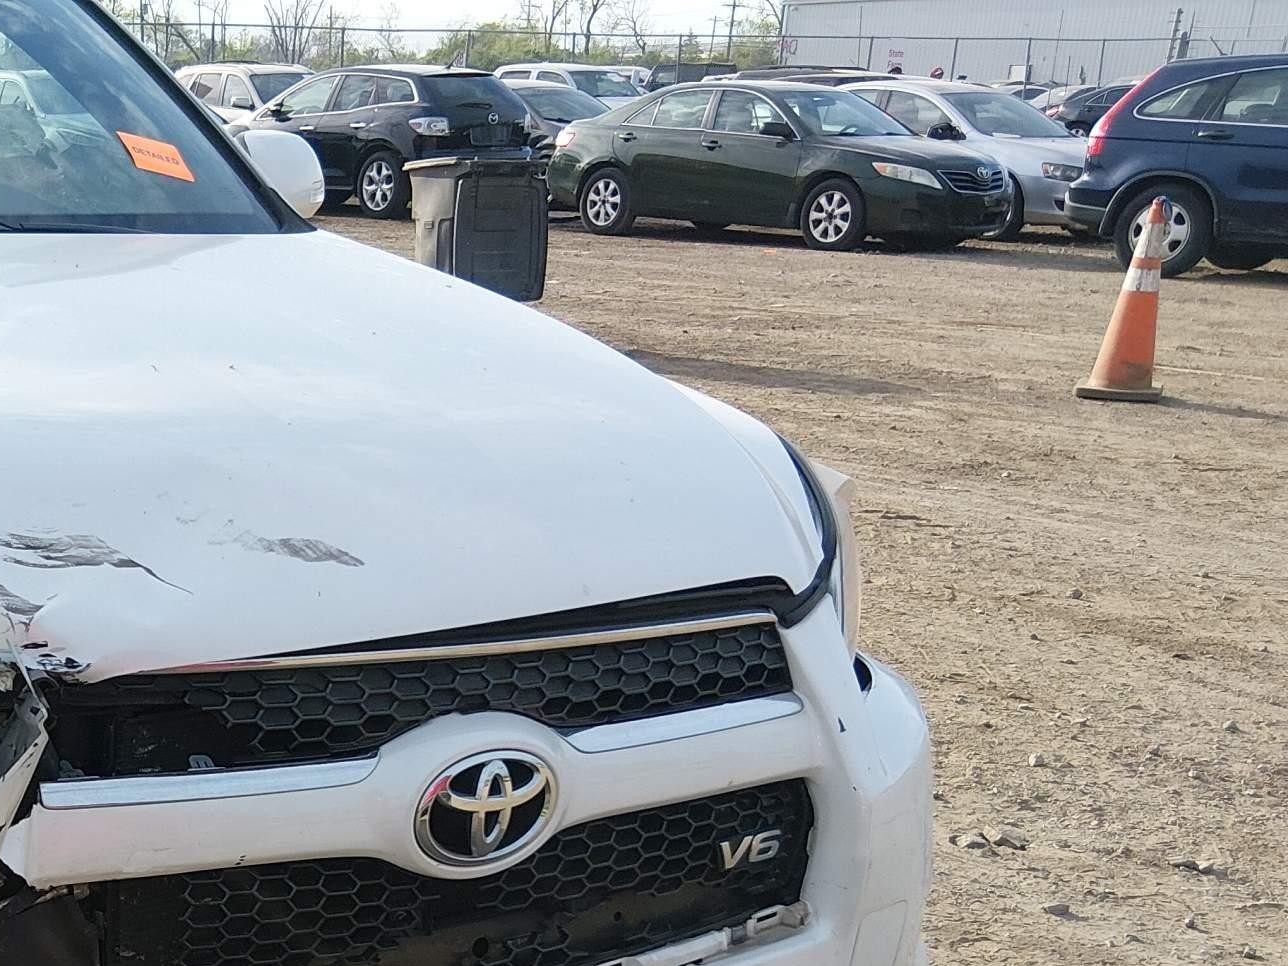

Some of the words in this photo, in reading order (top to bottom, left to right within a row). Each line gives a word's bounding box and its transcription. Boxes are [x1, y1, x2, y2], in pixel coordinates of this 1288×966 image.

[888, 49, 904, 58] State
[132, 146, 179, 165] DETAILED
[719, 829, 782, 870] V6
